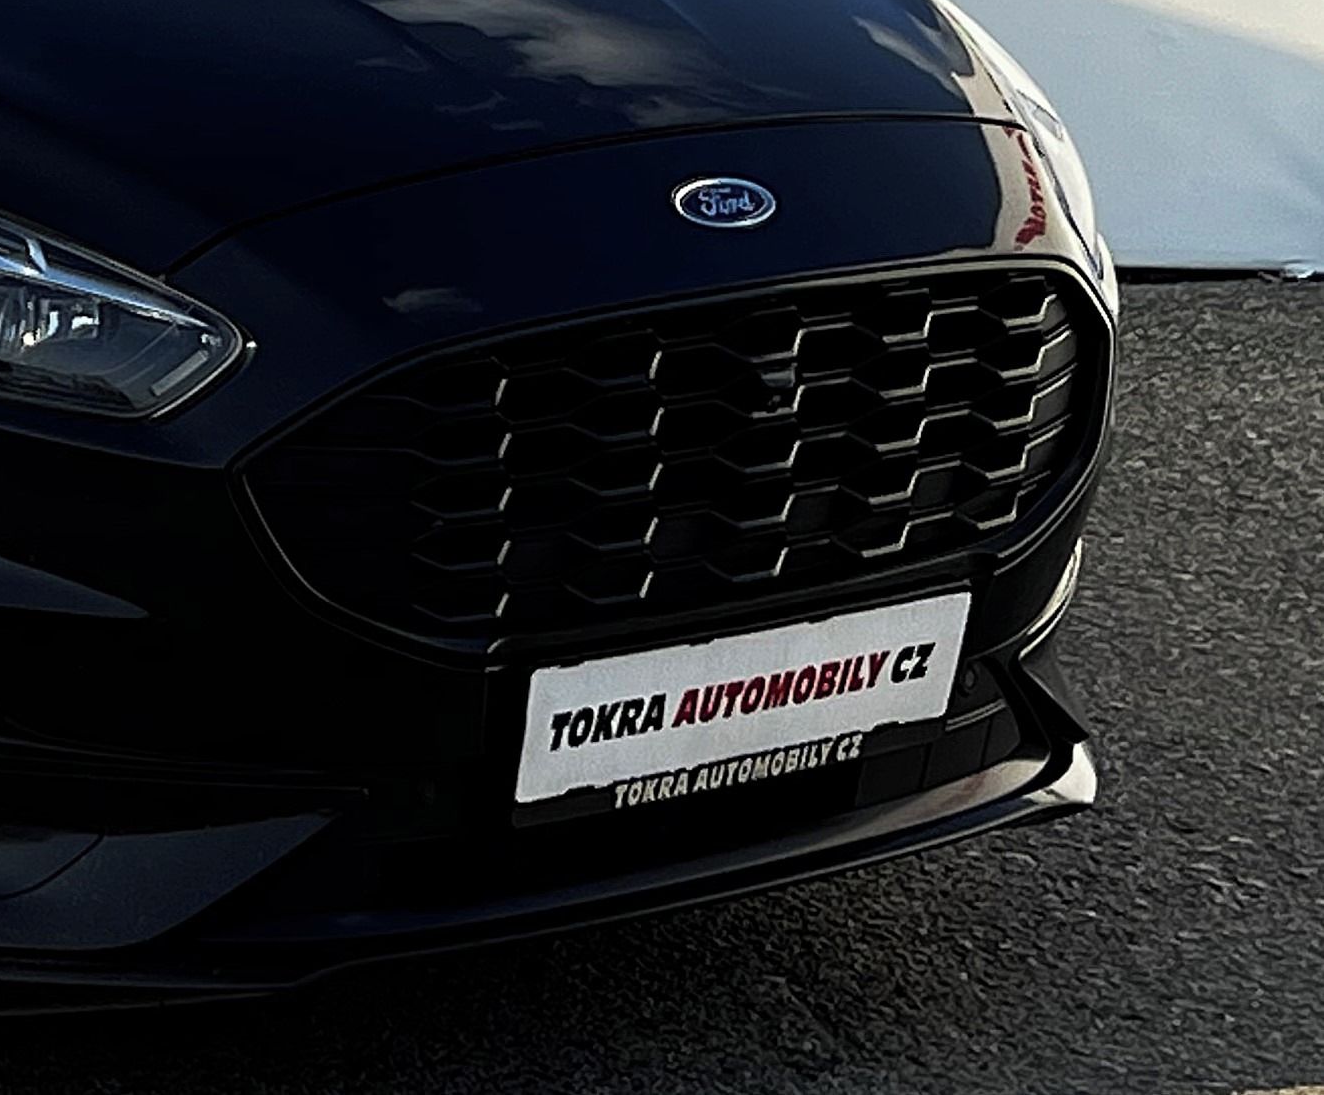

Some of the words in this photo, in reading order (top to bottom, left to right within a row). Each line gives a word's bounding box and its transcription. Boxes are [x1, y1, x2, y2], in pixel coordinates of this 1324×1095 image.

[698, 186, 756, 216] Ford
[550, 693, 667, 752] TOKRA
[671, 650, 891, 728] AUTOMOBILY
[891, 642, 936, 684] CZ
[615, 771, 689, 808] TOKRA
[692, 741, 833, 794] AUTOMOBILY
[836, 734, 863, 762] CZ
